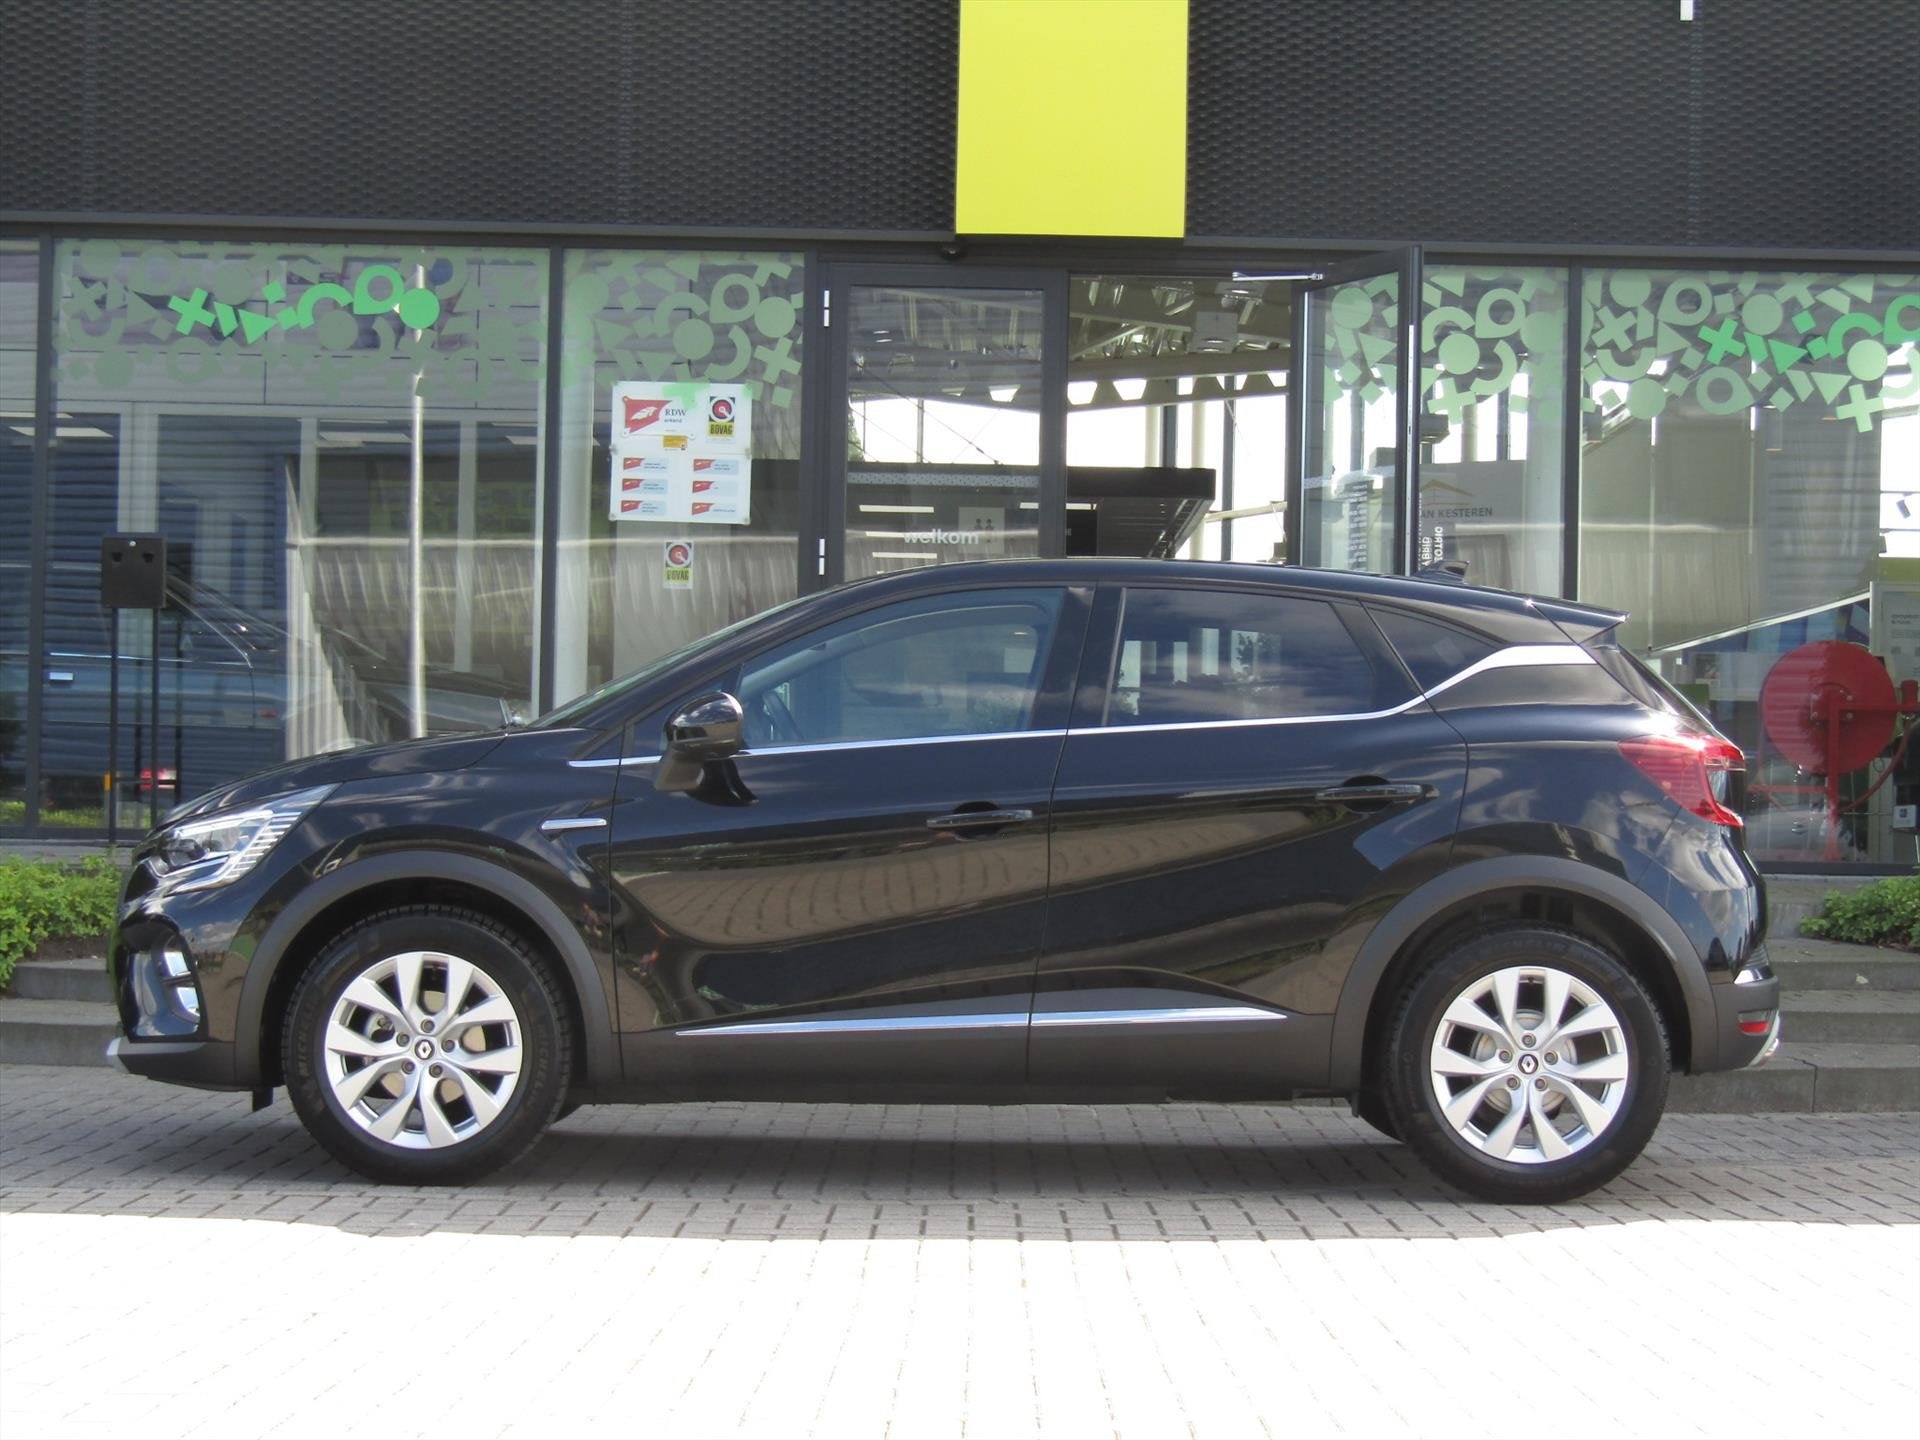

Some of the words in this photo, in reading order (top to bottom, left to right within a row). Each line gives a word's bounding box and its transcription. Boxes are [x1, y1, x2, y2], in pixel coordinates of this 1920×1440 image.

[664, 408, 687, 417] RDW
[710, 425, 733, 435] BOVAG
[1438, 507, 1493, 518] KESTEREN
[904, 528, 979, 544] welkom
